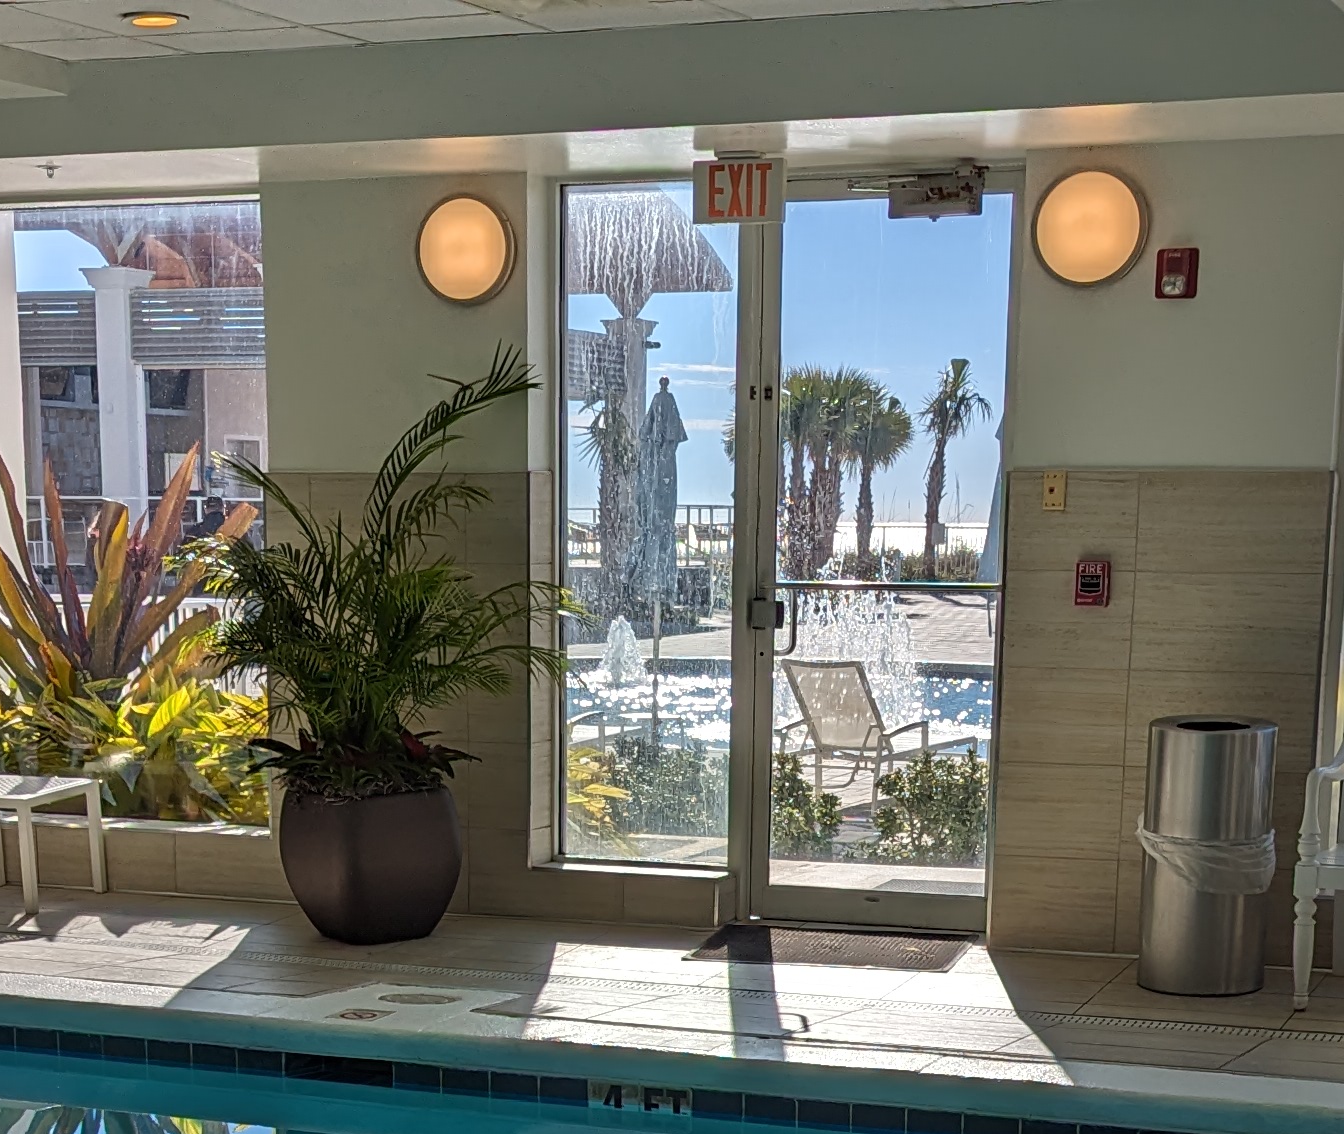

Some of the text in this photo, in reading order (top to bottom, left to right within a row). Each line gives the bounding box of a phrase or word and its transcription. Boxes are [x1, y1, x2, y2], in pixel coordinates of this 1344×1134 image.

[708, 162, 772, 218] EXIT
[1079, 564, 1103, 574] FIRE
[644, 1087, 687, 1114] FT
